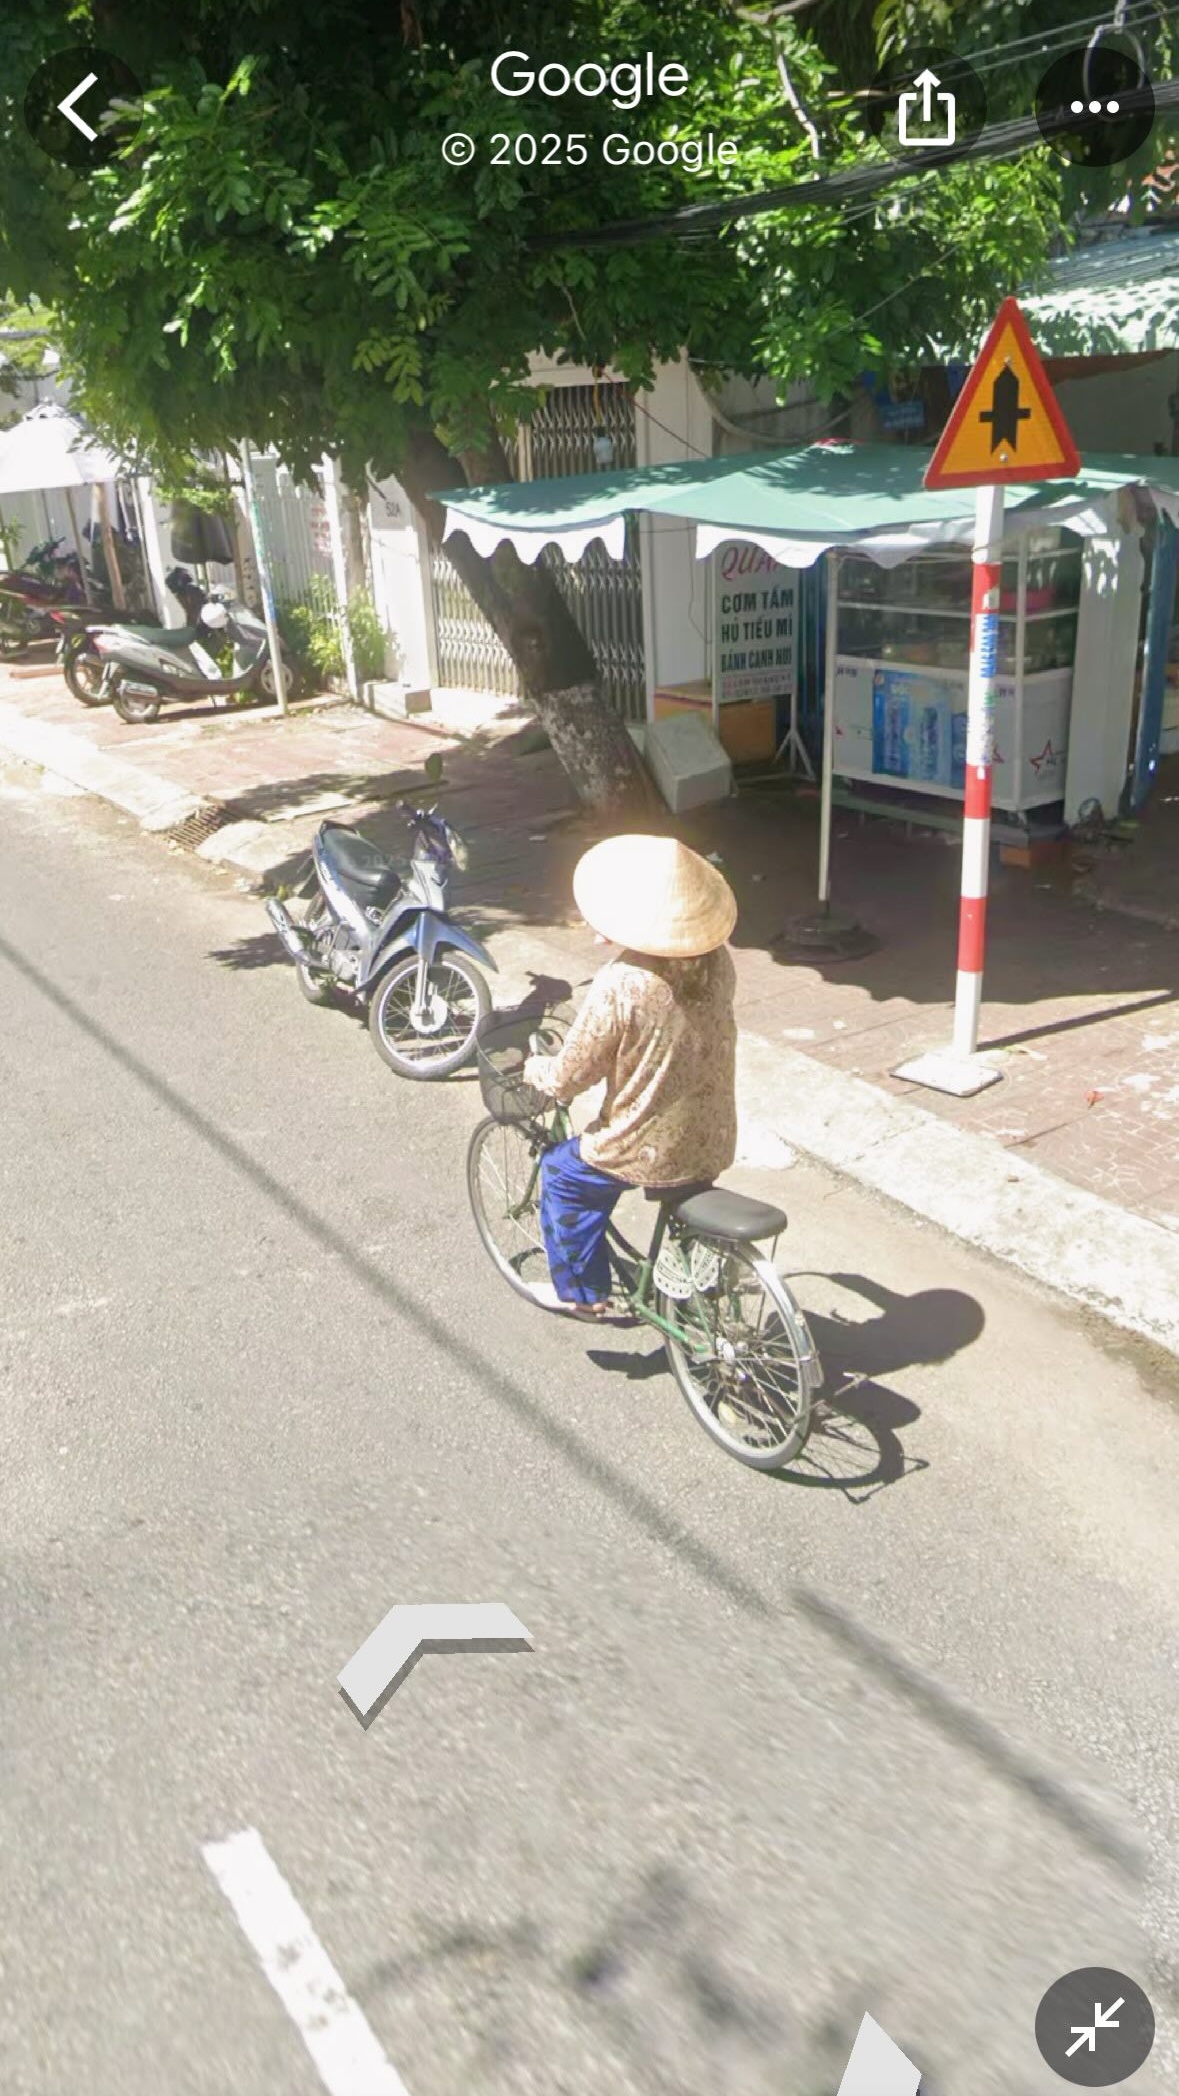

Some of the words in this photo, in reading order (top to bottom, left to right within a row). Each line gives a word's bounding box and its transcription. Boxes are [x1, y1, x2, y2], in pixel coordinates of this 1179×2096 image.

[721, 592, 757, 614] CƠM
[761, 584, 794, 611] TẤM
[721, 616, 740, 643] HỦ
[743, 613, 773, 640] TIẾU
[721, 648, 747, 673] BÁNH
[748, 649, 774, 669] CANH
